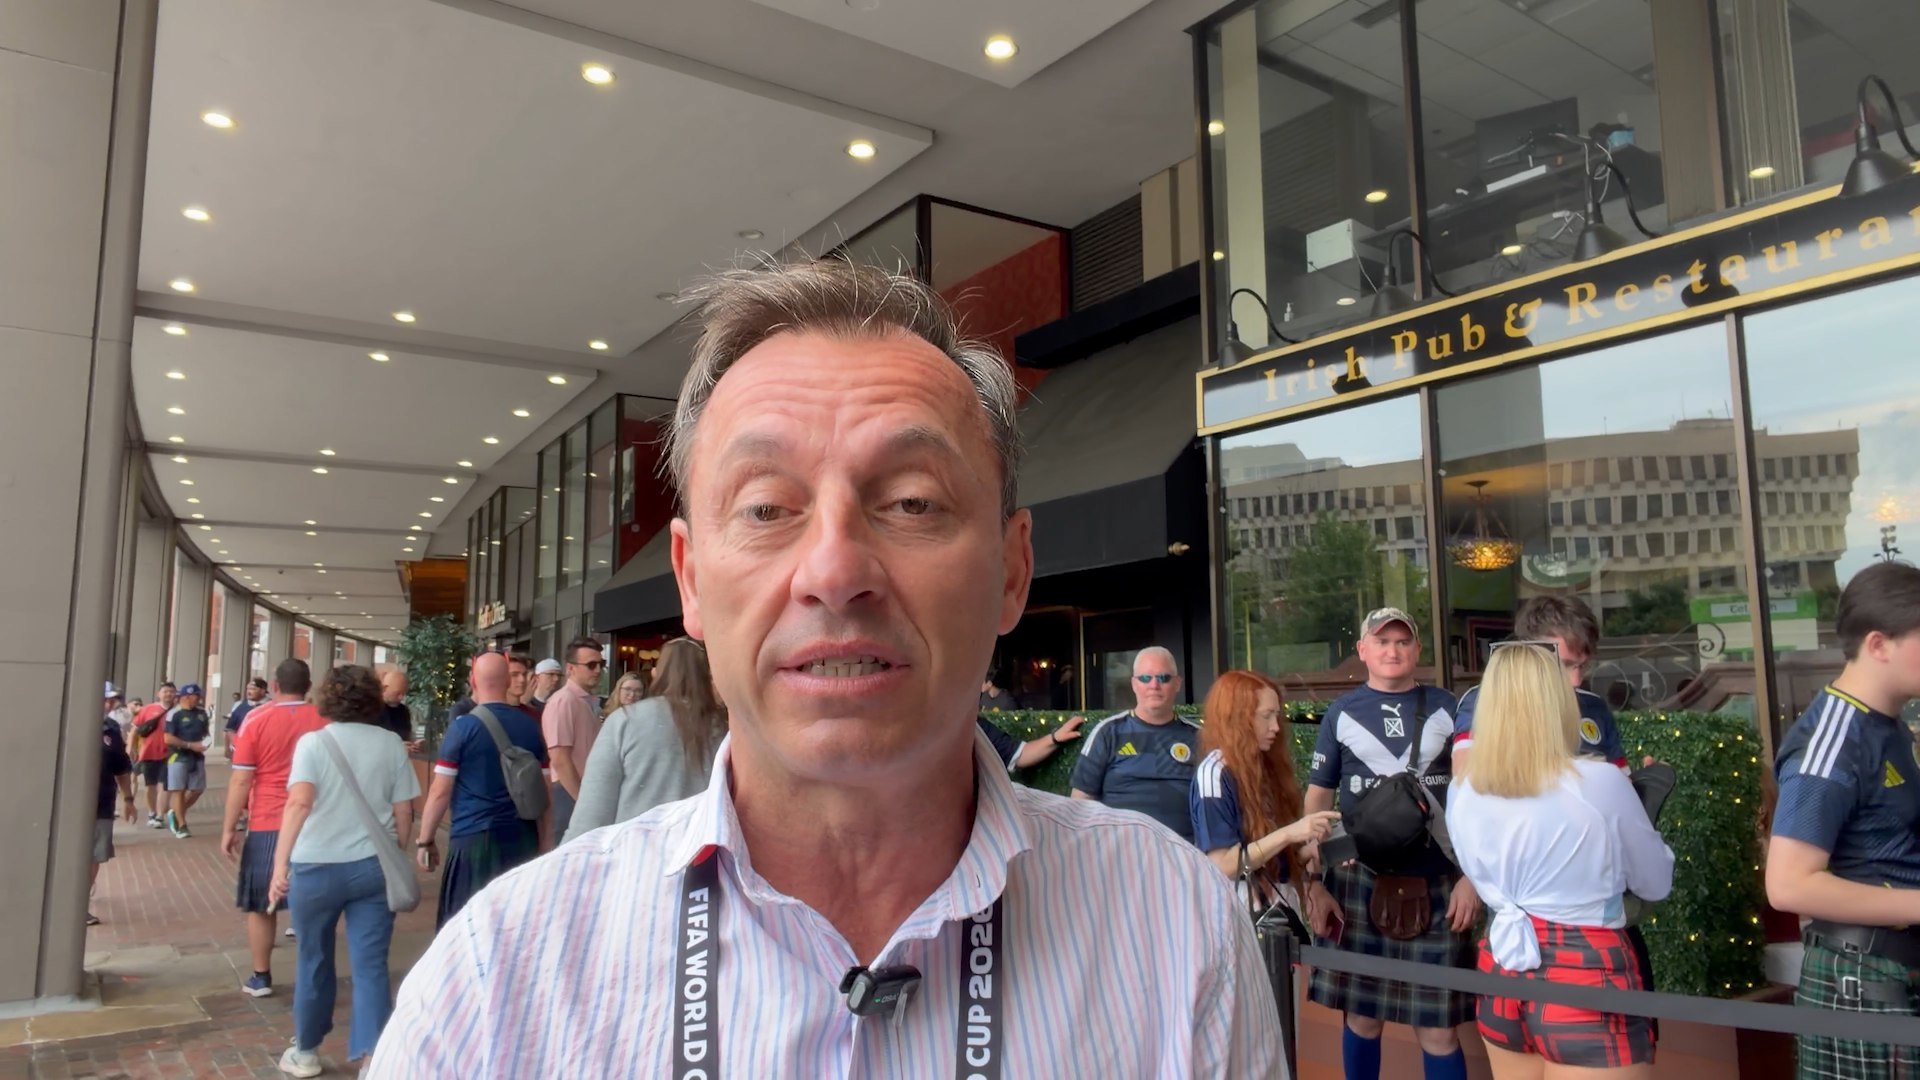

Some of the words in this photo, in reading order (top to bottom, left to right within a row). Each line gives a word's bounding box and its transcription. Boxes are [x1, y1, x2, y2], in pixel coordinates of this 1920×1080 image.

[1264, 346, 1368, 402] Irish
[1391, 313, 1487, 371] Pub
[1504, 297, 1543, 338] &
[1418, 775, 1451, 787] EGURO
[686, 886, 709, 950] FIFA
[683, 949, 708, 1063] WORLD
[965, 1004, 992, 1068] CUP
